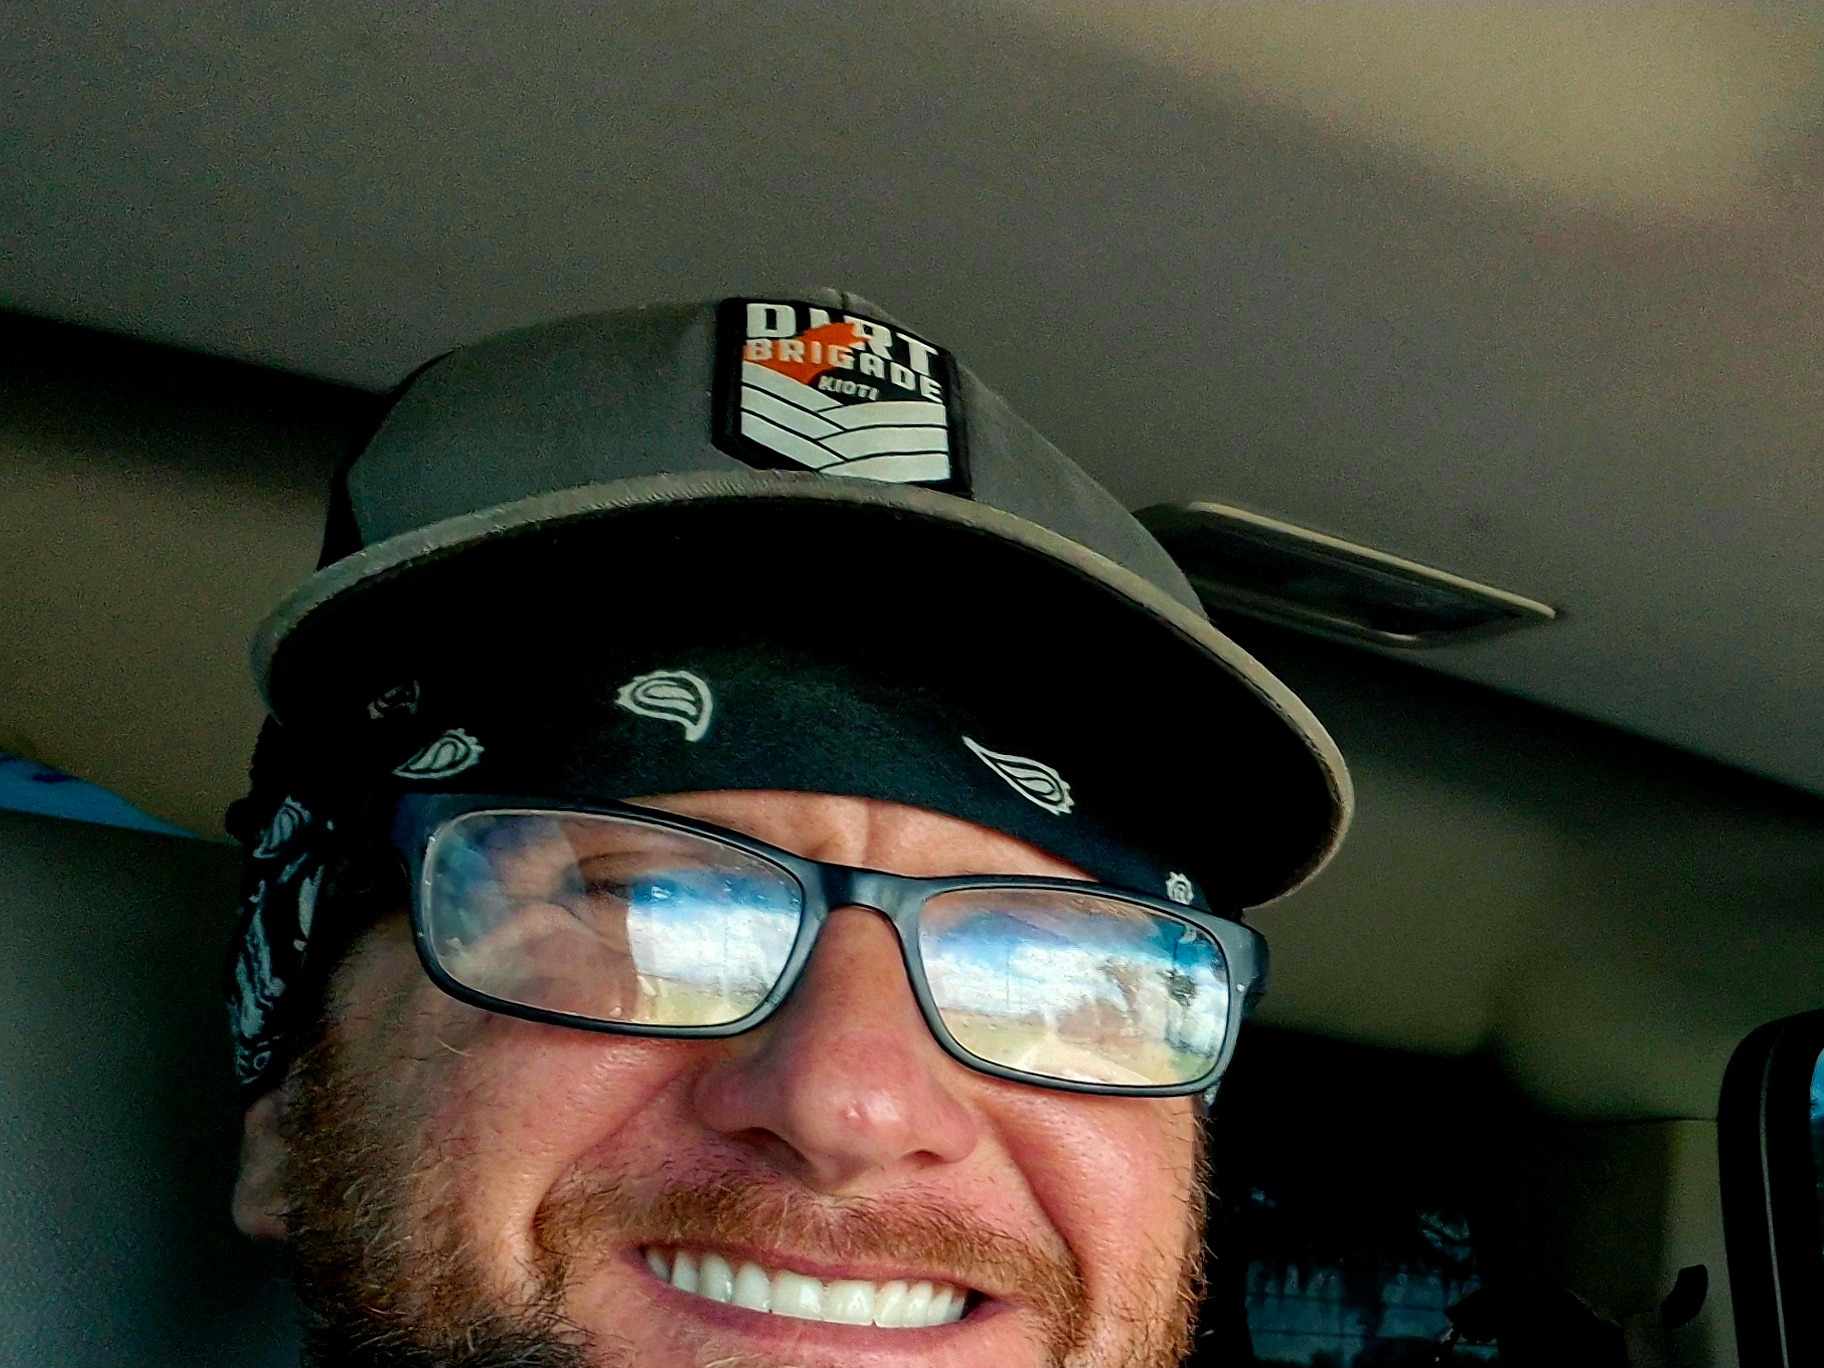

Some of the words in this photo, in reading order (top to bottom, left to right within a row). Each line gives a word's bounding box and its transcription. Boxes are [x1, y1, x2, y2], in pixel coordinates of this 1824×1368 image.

[745, 338, 944, 404] BRIGADE
[746, 303, 939, 376] DIRT
[818, 375, 880, 401] KIOTI
